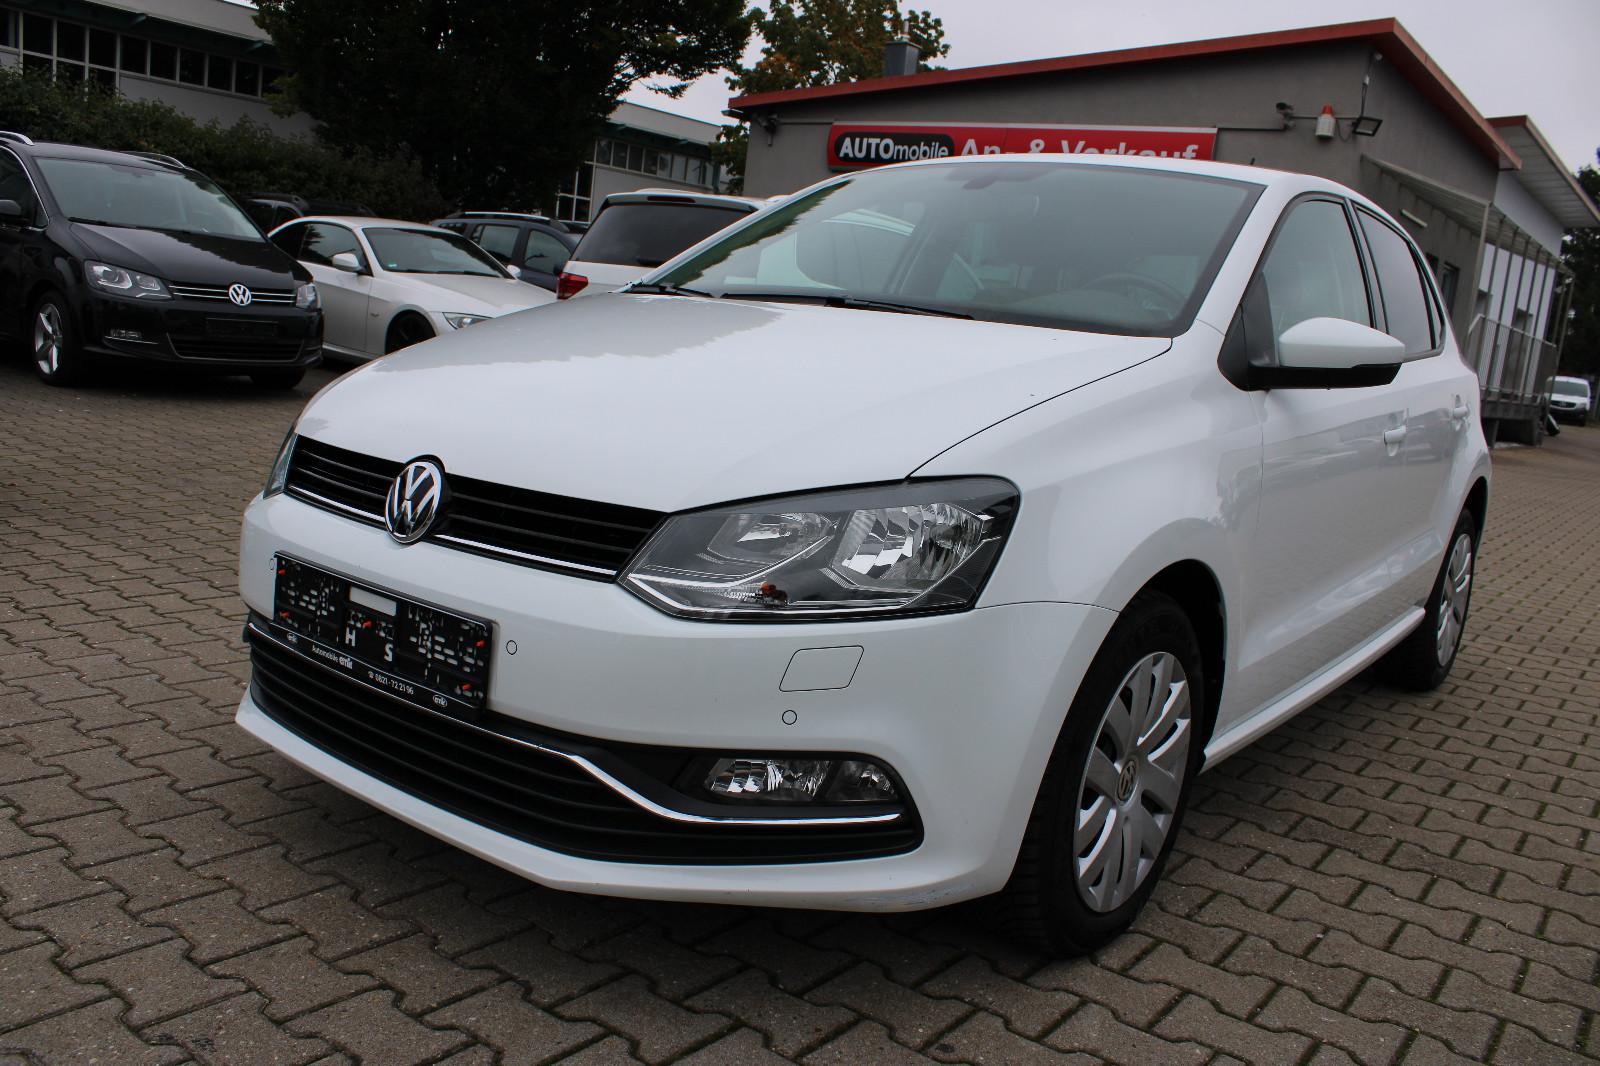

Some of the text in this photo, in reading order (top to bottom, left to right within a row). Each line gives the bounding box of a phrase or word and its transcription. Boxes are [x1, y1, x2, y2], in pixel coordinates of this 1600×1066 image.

[839, 137, 949, 161] AUTOmobile
[1028, 138, 1046, 153] &
[229, 284, 251, 306] VW
[385, 461, 442, 543] VW
